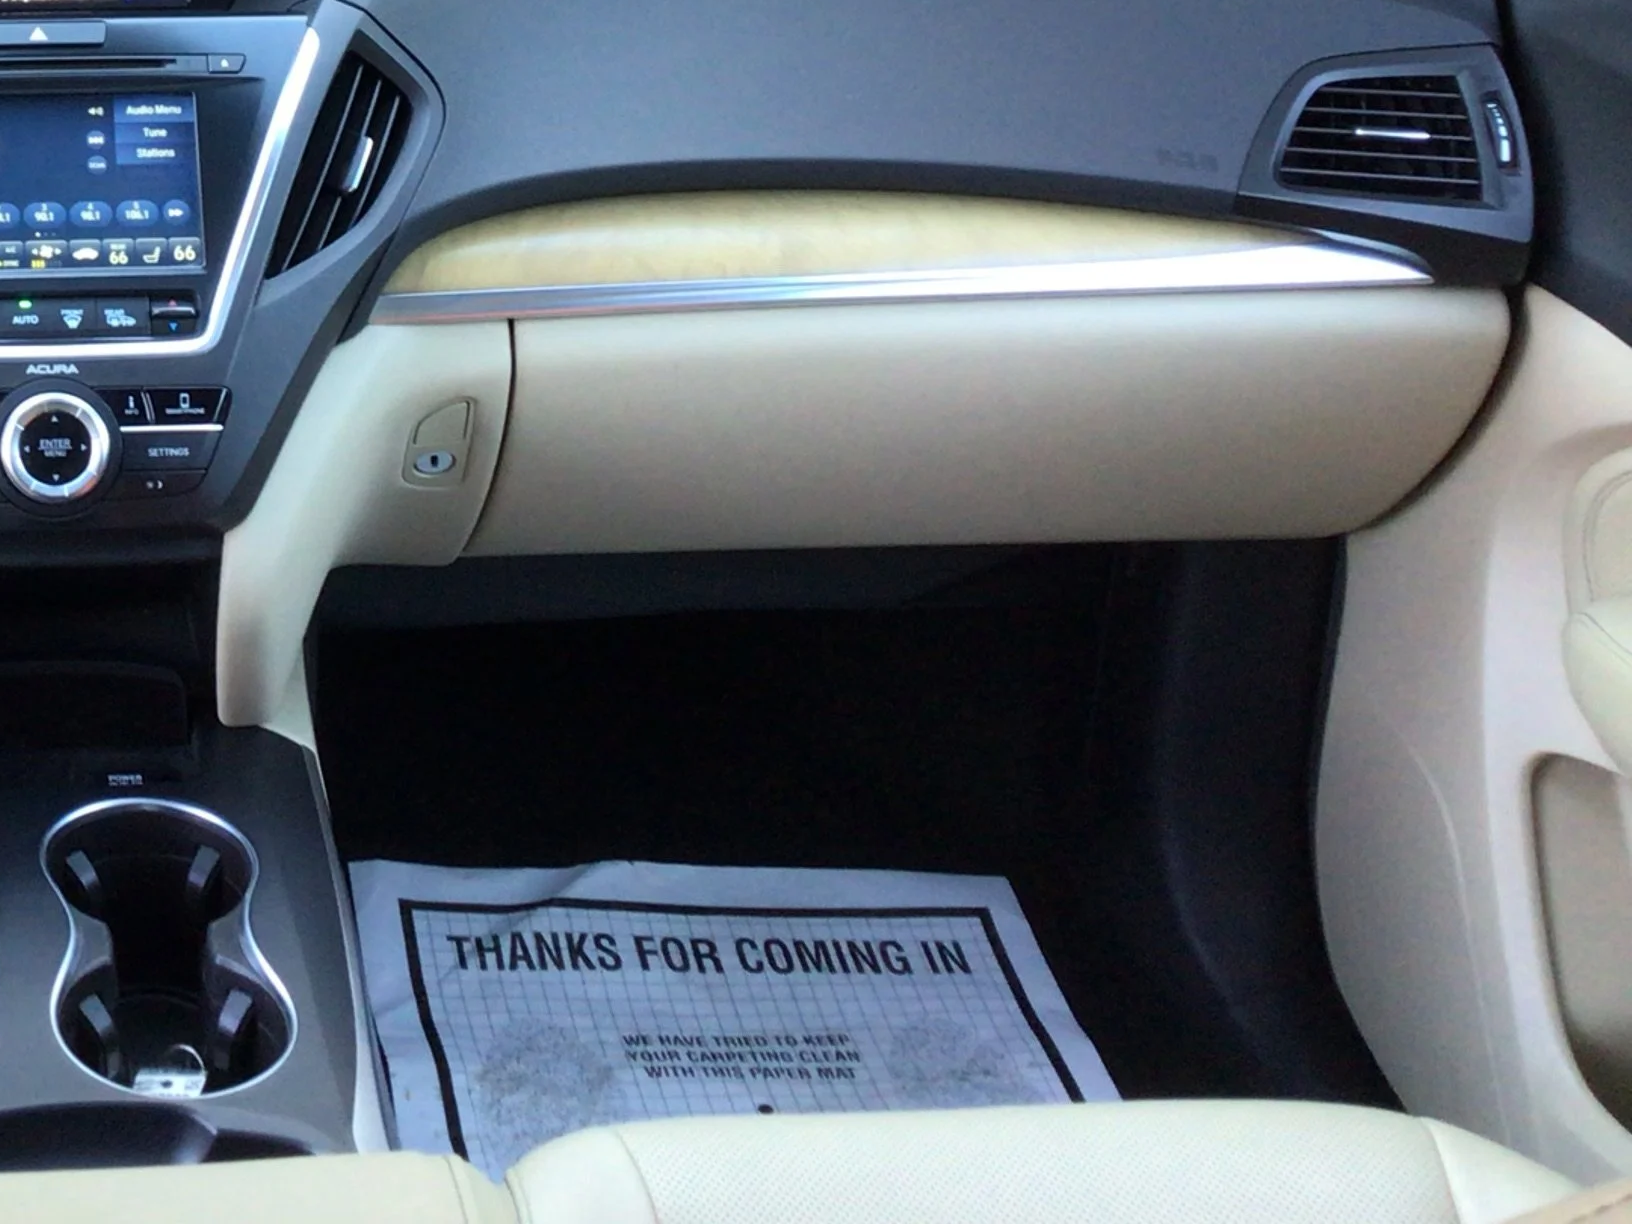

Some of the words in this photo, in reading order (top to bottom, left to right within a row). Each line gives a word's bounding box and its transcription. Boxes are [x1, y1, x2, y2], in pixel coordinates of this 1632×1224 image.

[126, 105, 153, 115] Audio
[155, 105, 182, 115] Menu
[143, 127, 168, 138] Tune
[136, 148, 176, 159] Stations
[109, 251, 128, 265] 66
[173, 245, 197, 261] 66
[12, 315, 39, 325] AUTO
[26, 364, 79, 375] ACURA
[40, 439, 71, 448] ENTER
[148, 447, 190, 457] SETTINGS
[446, 931, 622, 973] THANKS
[633, 934, 725, 975] FOR
[734, 937, 914, 976] COMING
[921, 940, 970, 975] IN
[622, 1034, 654, 1047] WE
[658, 1034, 708, 1048] HAVE
[711, 1034, 768, 1048] TRIED
[773, 1034, 798, 1047] TO
[802, 1033, 850, 1046] KEEP
[625, 1050, 681, 1063] YOUR
[686, 1050, 794, 1063] CARPETING
[799, 1050, 861, 1063] CLEAN
[643, 1065, 696, 1078] WITH
[700, 1065, 744, 1079] THIS
[749, 1066, 811, 1079] PAPER
[816, 1066, 857, 1079] MAT
